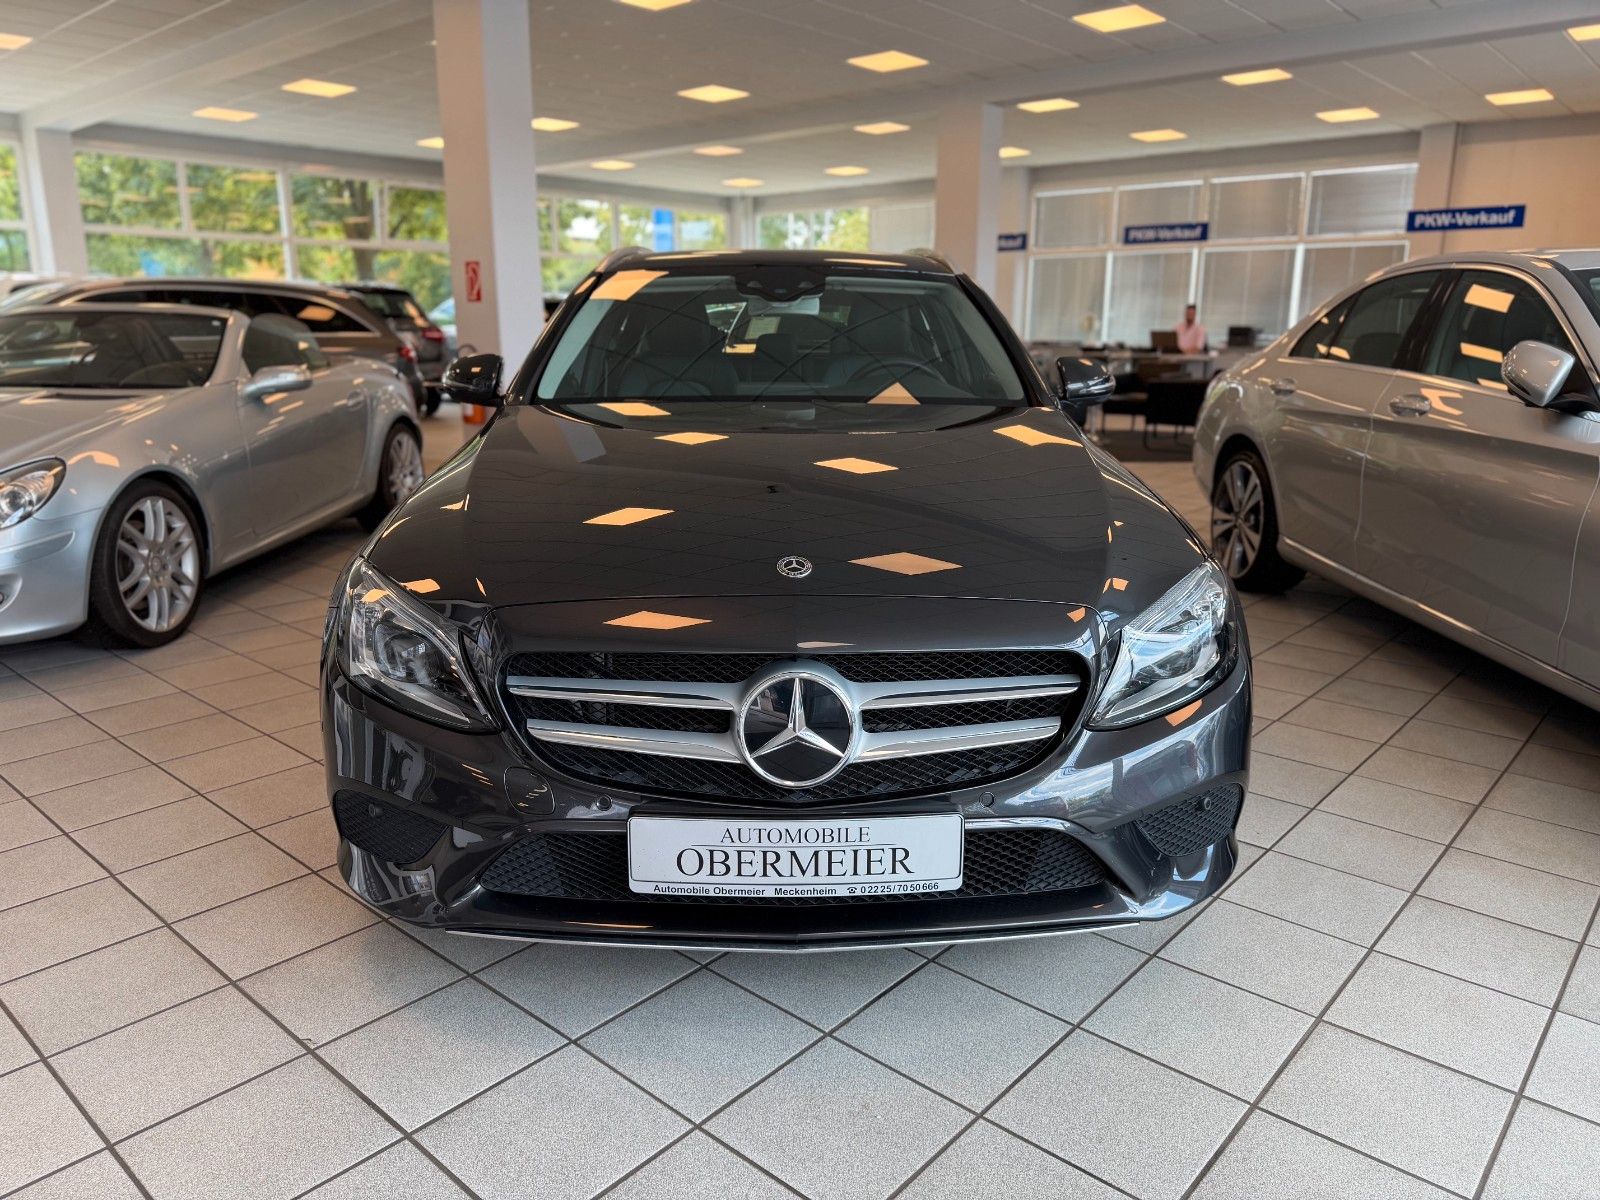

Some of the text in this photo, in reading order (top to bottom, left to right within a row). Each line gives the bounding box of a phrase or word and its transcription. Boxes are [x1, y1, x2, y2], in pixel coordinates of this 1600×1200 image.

[1414, 208, 1517, 229] PKW-Verkauf
[720, 826, 871, 844] AUTOMOBILE
[676, 847, 915, 878] OBERMEIER
[653, 884, 710, 895] Automobile
[713, 886, 766, 896] Obermeier
[774, 887, 837, 896] Meckenheim
